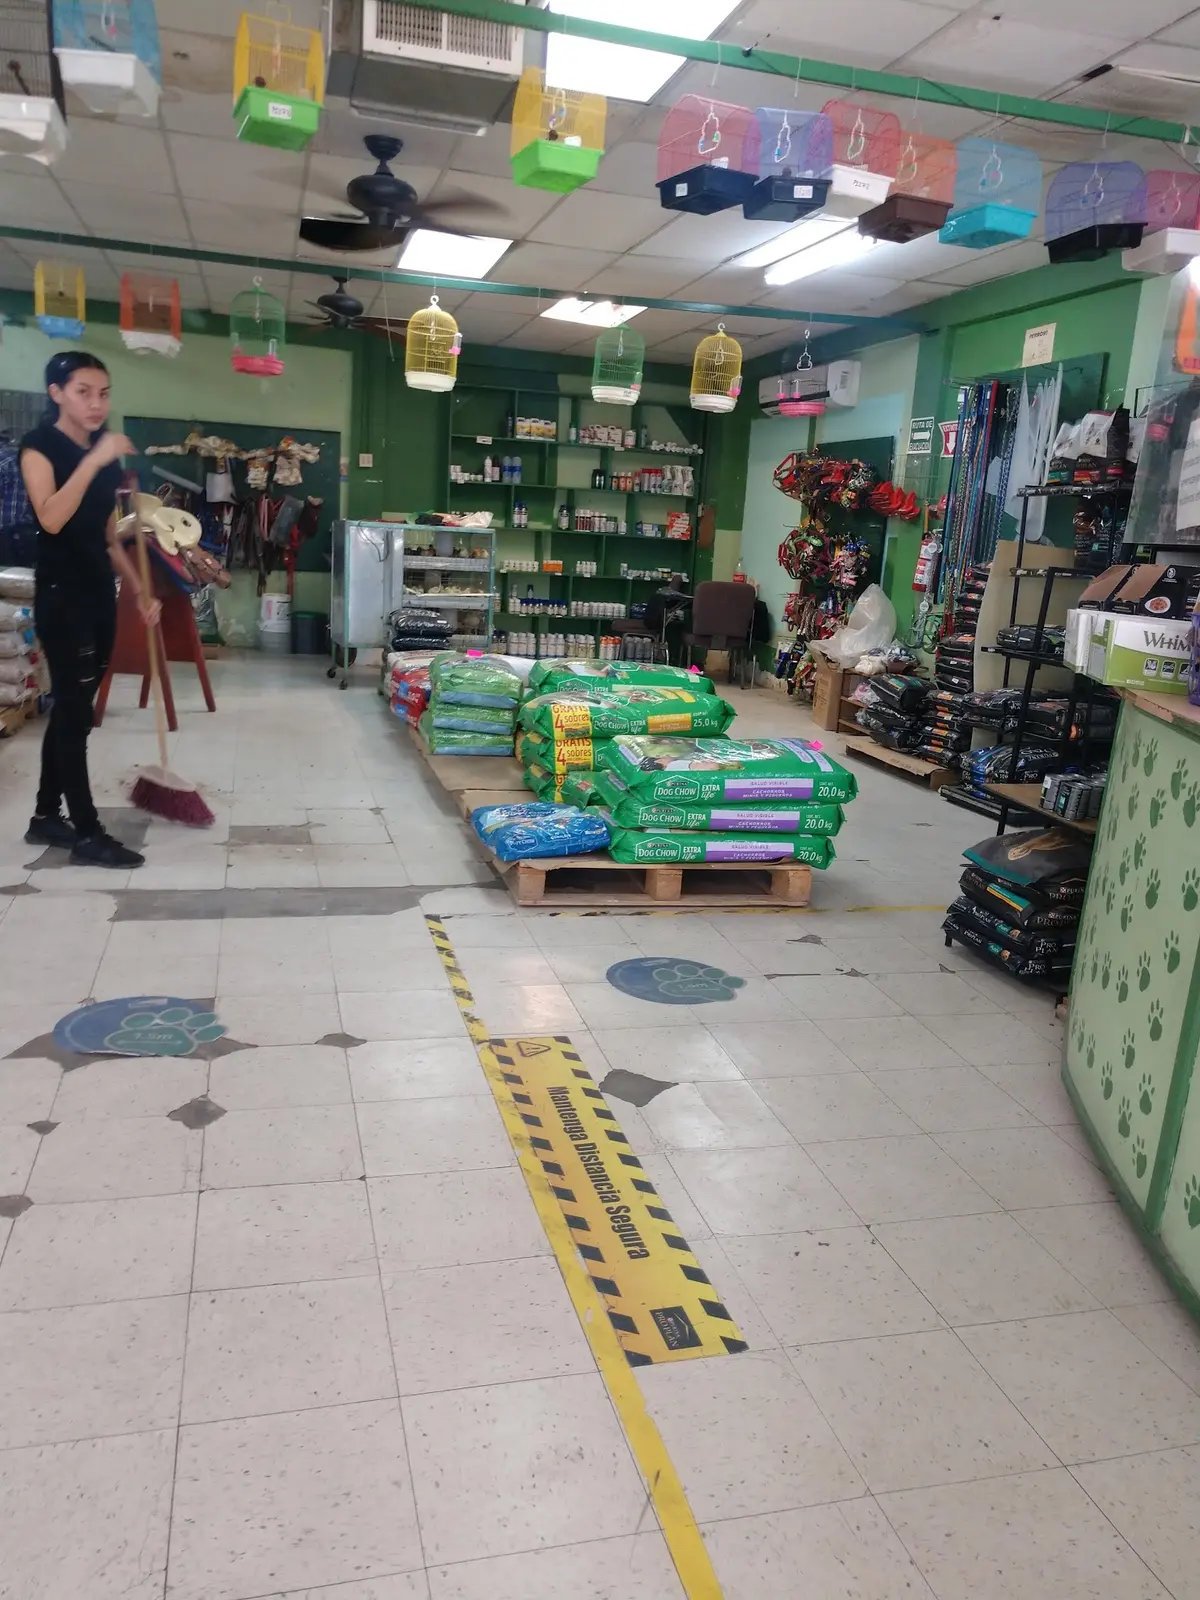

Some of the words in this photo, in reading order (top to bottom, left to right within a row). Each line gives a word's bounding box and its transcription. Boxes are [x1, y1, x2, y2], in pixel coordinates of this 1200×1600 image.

[912, 421, 925, 430] RUTA
[926, 420, 933, 428] DE
[1143, 630, 1191, 652] WHIM
[552, 705, 588, 714] GRATIS
[564, 712, 589, 723] sobres
[554, 714, 565, 733] 4
[594, 720, 608, 729] DOG
[608, 720, 627, 730] CHOW
[693, 718, 710, 728] 25,0
[710, 719, 718, 728] kg
[556, 748, 566, 766] 4
[566, 746, 592, 758] sobres
[657, 787, 674, 796] DOG
[674, 787, 697, 796] CHOW
[701, 784, 720, 792] EXTRA
[818, 786, 837, 798] 20,0
[837, 788, 846, 799] kg
[700, 791, 716, 801] life
[641, 812, 659, 822] DOG
[659, 813, 683, 823] CHOW
[687, 812, 706, 821] EXTRA
[804, 818, 824, 829] 20,0
[824, 820, 833, 830] kg
[638, 848, 655, 857] DOG
[655, 848, 678, 857] CHOW
[683, 846, 702, 854] EXTRA
[797, 851, 817, 861] 20,0
[816, 854, 824, 864] kg
[546, 1086, 589, 1142] Mantenga
[573, 1142, 621, 1204] Distancia
[604, 1204, 651, 1260] Segura
